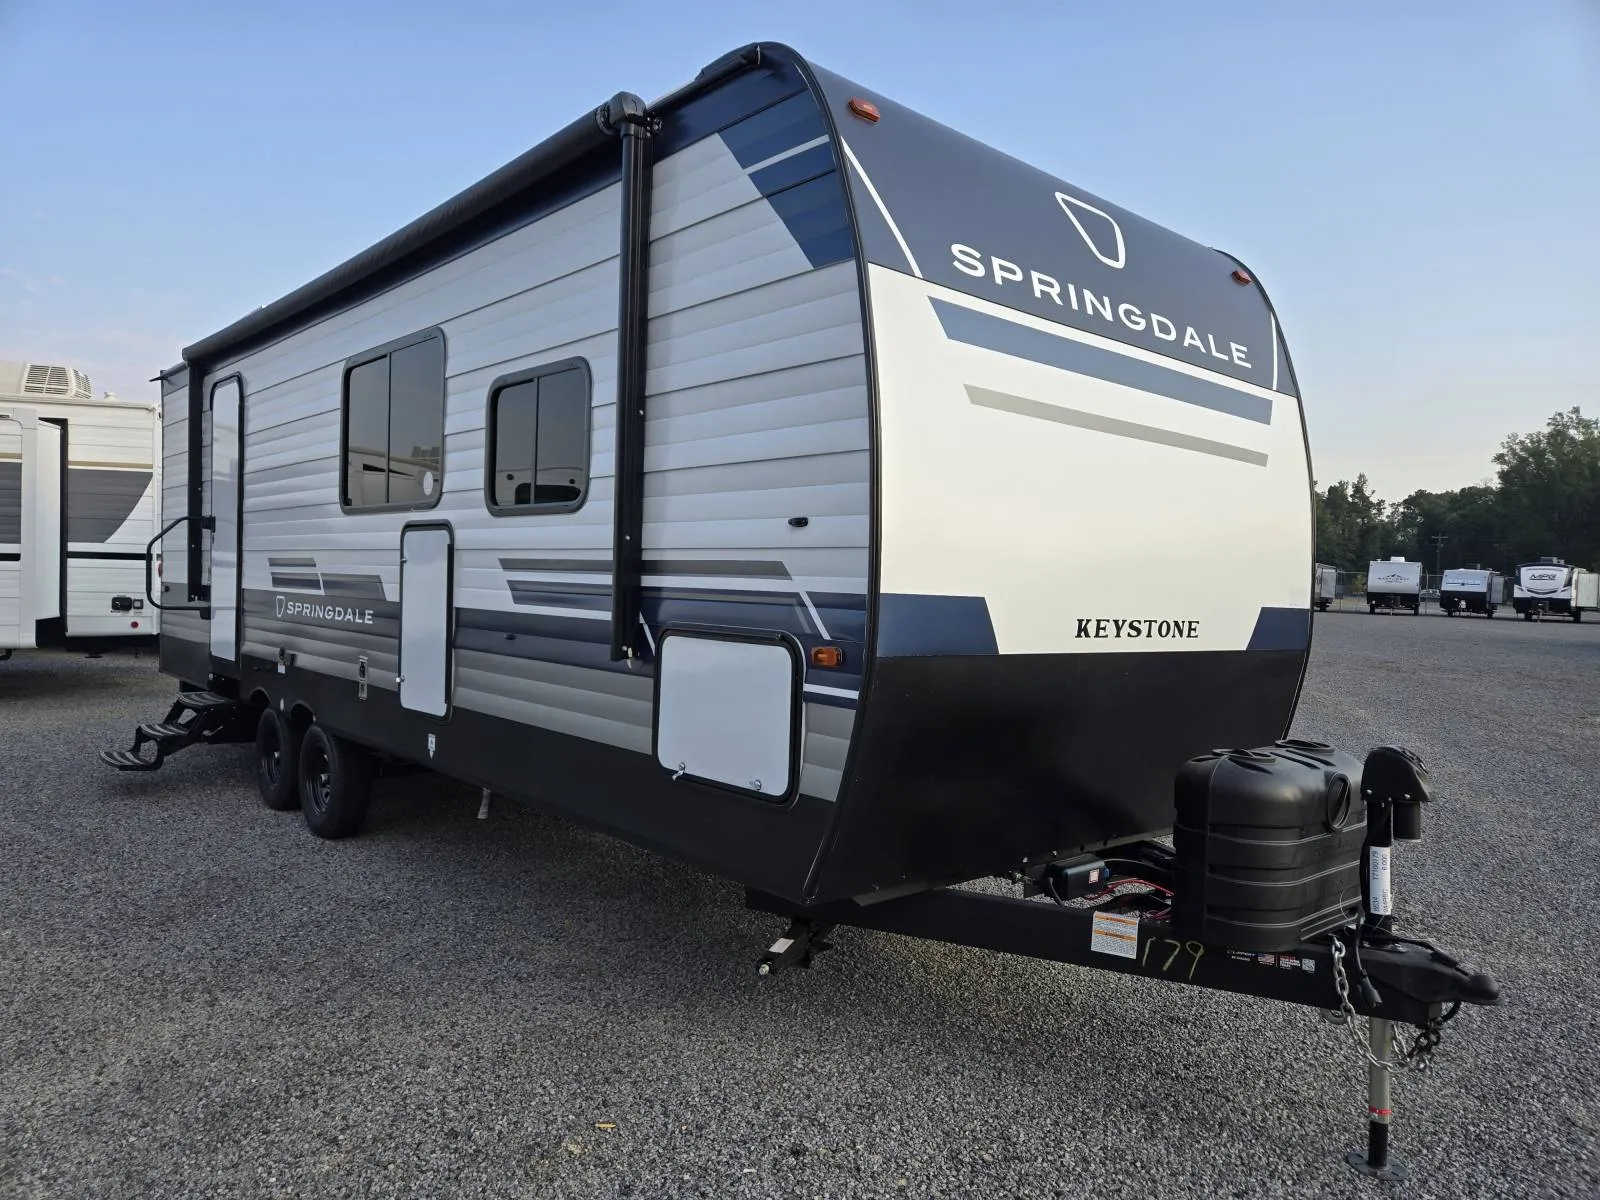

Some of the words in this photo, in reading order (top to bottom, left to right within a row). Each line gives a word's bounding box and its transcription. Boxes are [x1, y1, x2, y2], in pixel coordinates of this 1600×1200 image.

[951, 243, 1252, 369] SPRINGDALE
[286, 601, 374, 625] SPRINGDALE
[1074, 618, 1200, 638] KEYSTONE
